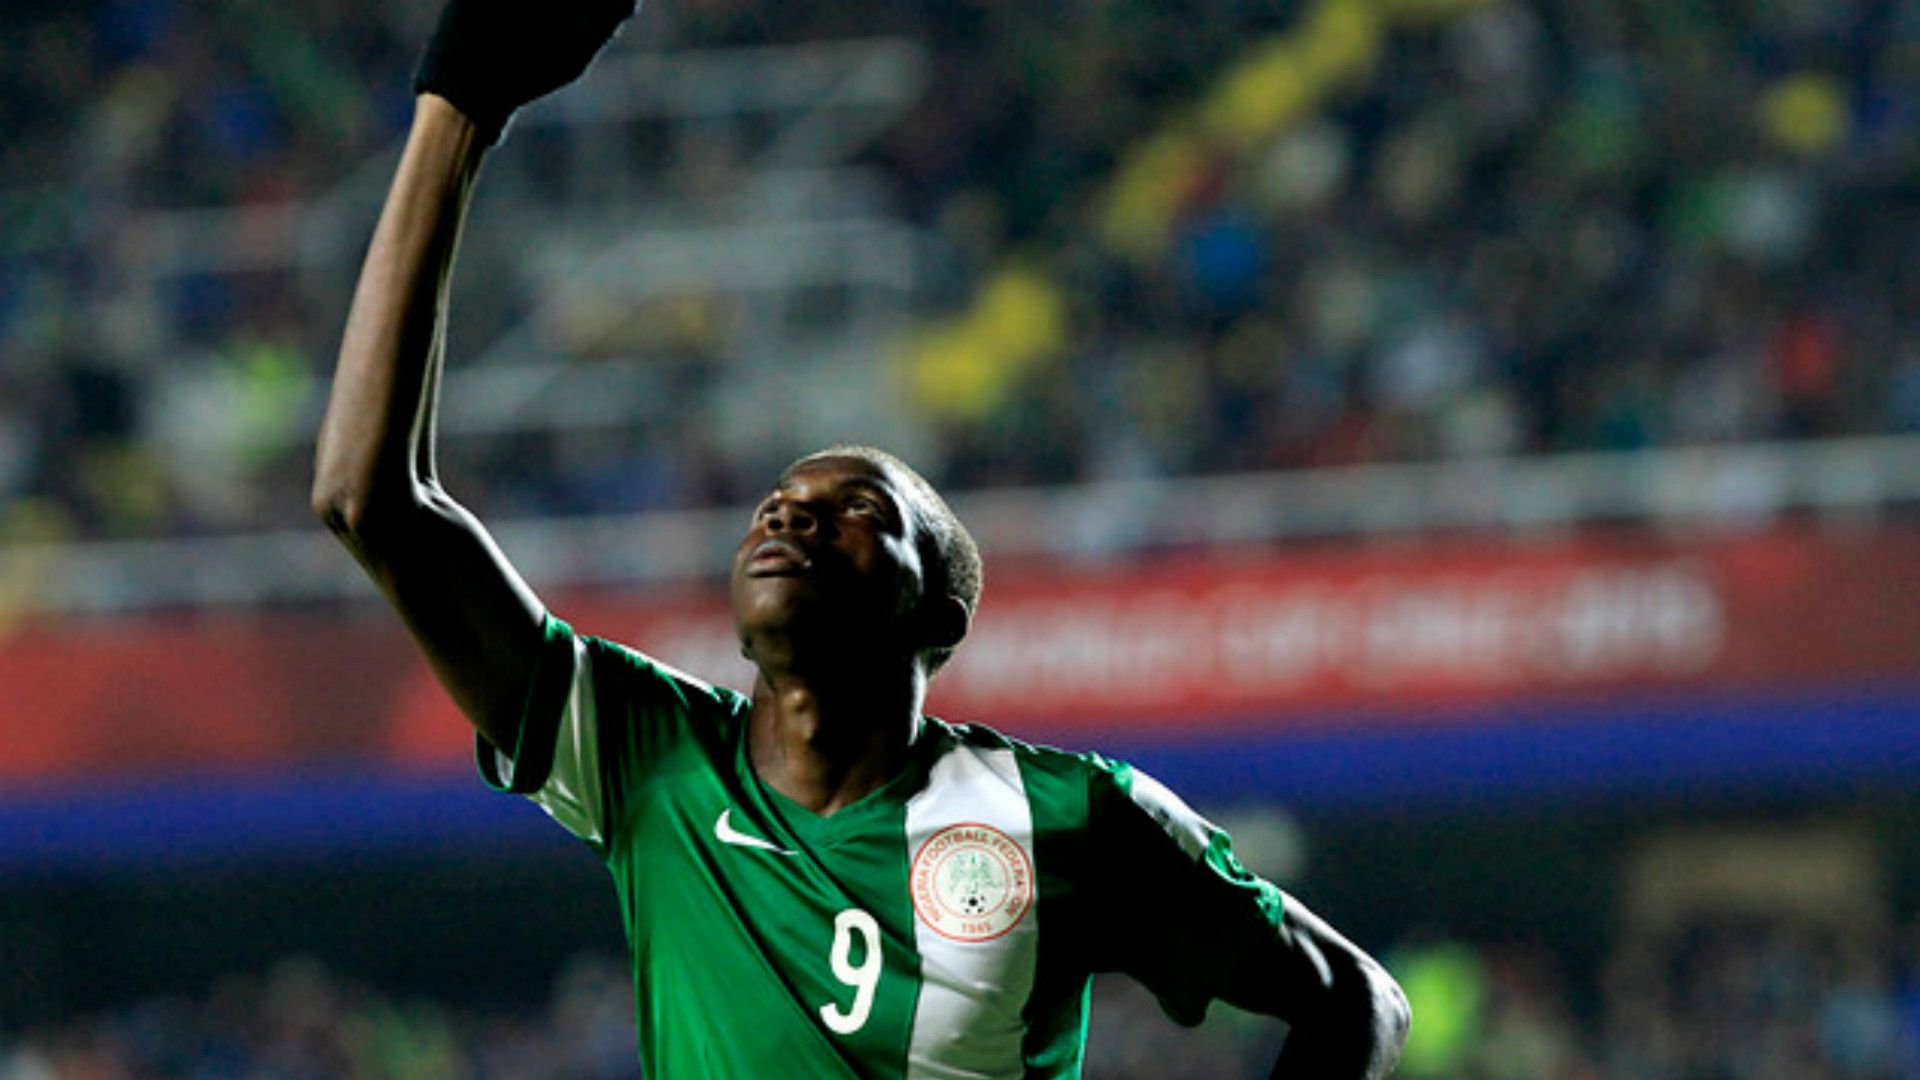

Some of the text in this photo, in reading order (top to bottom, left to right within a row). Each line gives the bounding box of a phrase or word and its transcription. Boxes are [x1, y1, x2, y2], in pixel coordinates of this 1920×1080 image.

[923, 829, 988, 867] FOOTBALL
[992, 837, 1026, 919] FEDERAON
[819, 908, 882, 1035] 9
